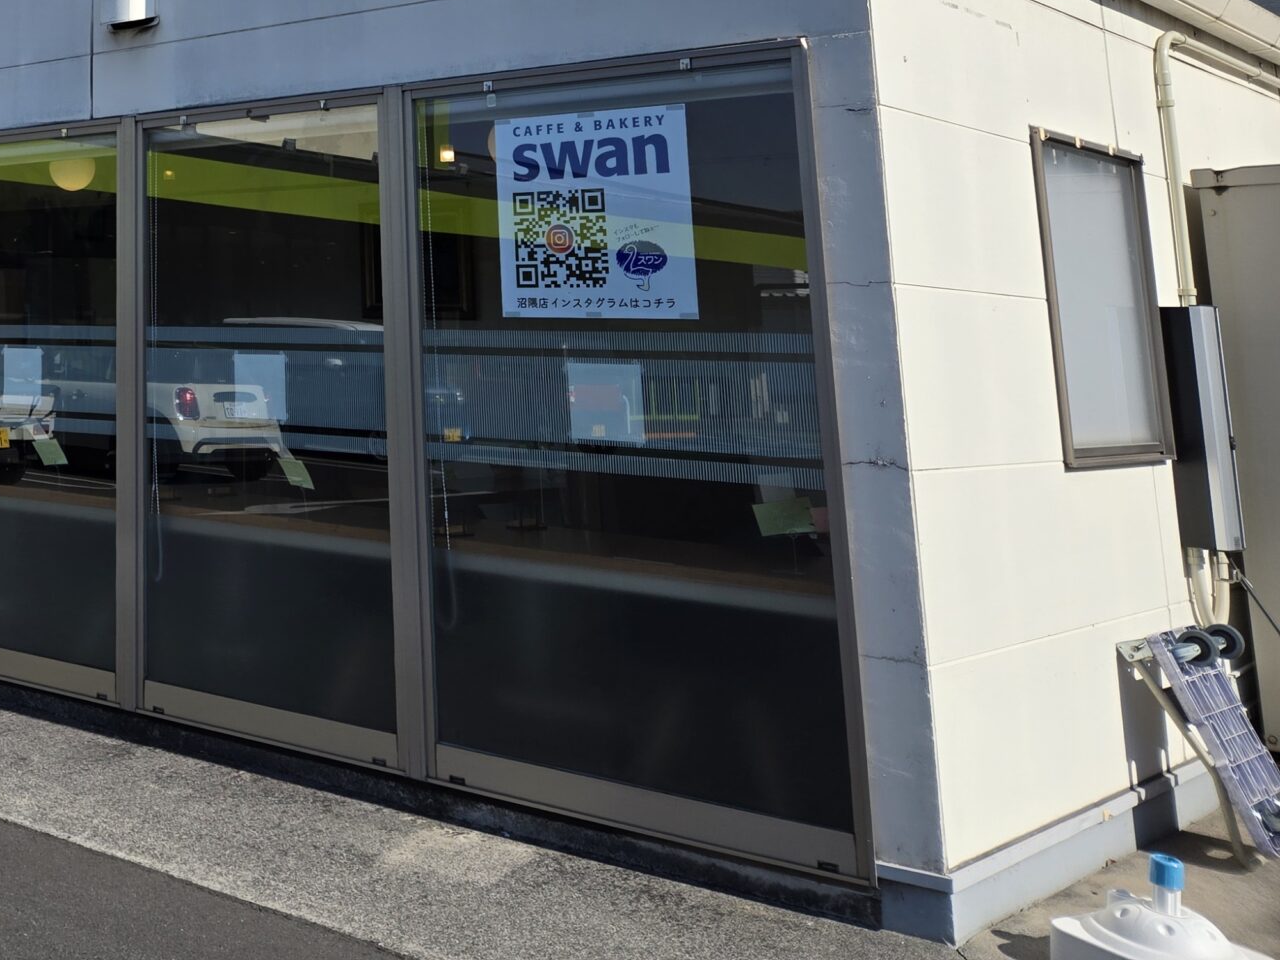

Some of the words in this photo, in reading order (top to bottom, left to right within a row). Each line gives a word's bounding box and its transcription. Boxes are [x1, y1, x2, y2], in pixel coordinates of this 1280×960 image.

[512, 122, 565, 137] CAFFE
[574, 121, 584, 133] &
[593, 114, 666, 131] BAKERY
[512, 133, 670, 182] swan
[638, 256, 662, 264] スワン
[517, 297, 676, 309] 沼隈店インスタグラムはコチラ
